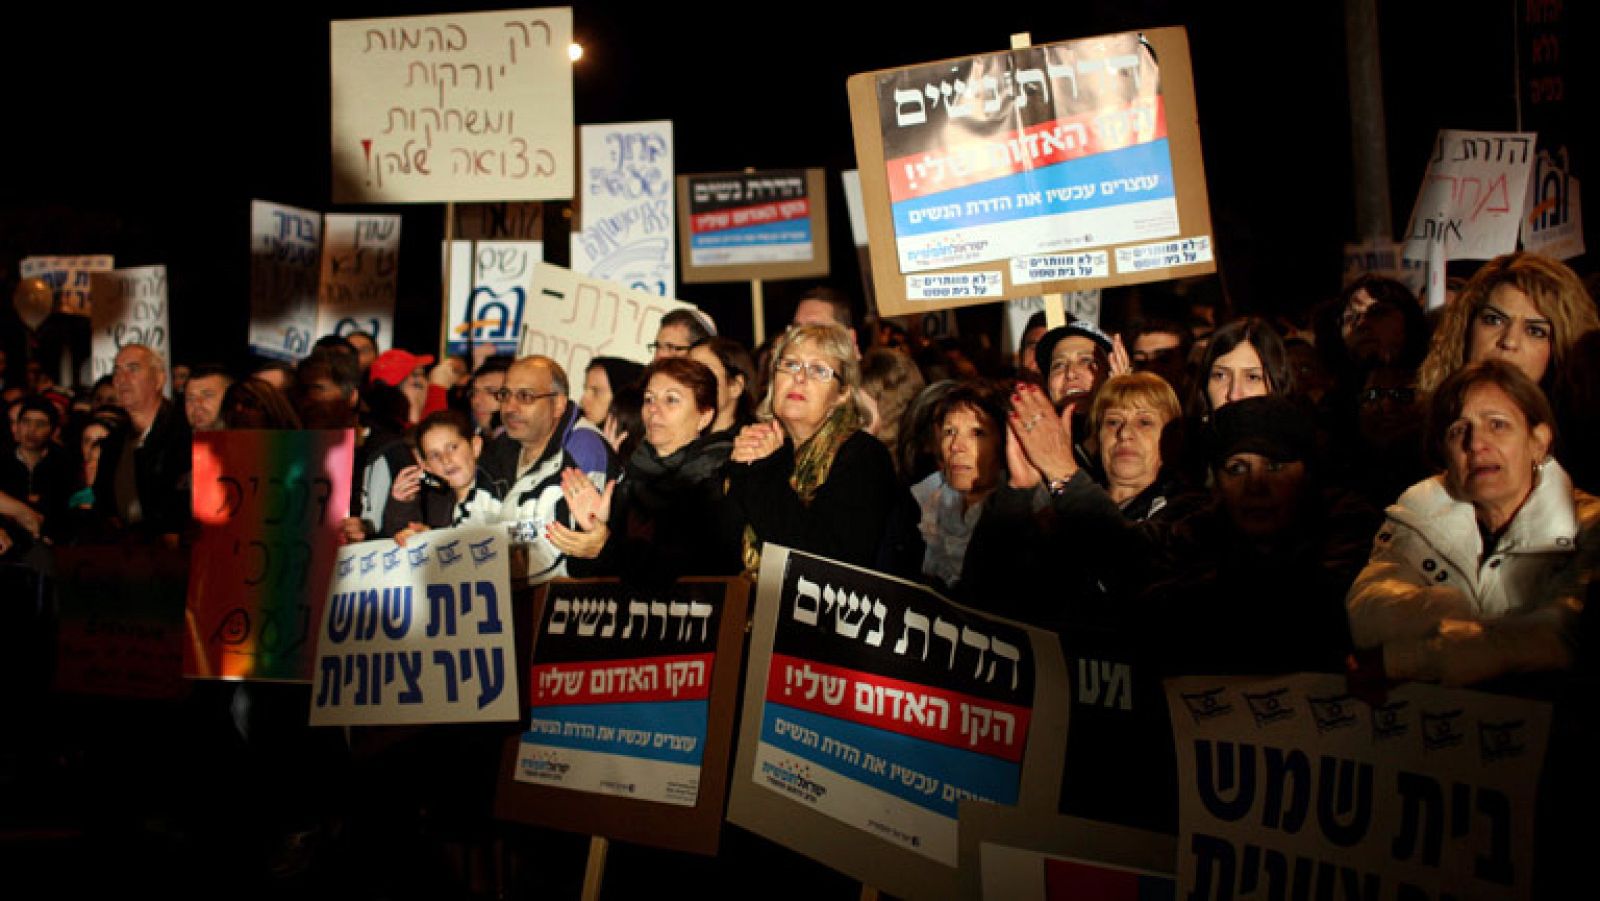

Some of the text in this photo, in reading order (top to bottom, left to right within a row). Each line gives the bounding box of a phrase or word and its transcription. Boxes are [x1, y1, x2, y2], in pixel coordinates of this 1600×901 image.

[364, 21, 551, 64] רק בהמות
[405, 61, 506, 108] יורקות
[383, 107, 515, 149] ומשחקות
[452, 138, 556, 181] בצואה
[1452, 137, 1531, 165] הדרת
[908, 173, 1160, 225] עוצרים עכשיו את הדרת הנשים
[327, 579, 503, 645] בית שמש
[547, 597, 713, 643] הדרת נשים
[792, 575, 1021, 692] הדרת נשים
[316, 645, 505, 711] עיר ציונית
[537, 659, 705, 699] הקו האדום שלי!
[784, 663, 1015, 748] הקו האדום שלי!
[597, 724, 615, 742] את
[618, 726, 652, 747] עכשיו
[653, 731, 697, 753] עוצרים
[774, 716, 820, 750] הנשים
[820, 735, 862, 767] הדרת
[861, 751, 888, 777] את
[888, 761, 940, 796] עכשיו
[1194, 739, 1515, 886] בית שמש
